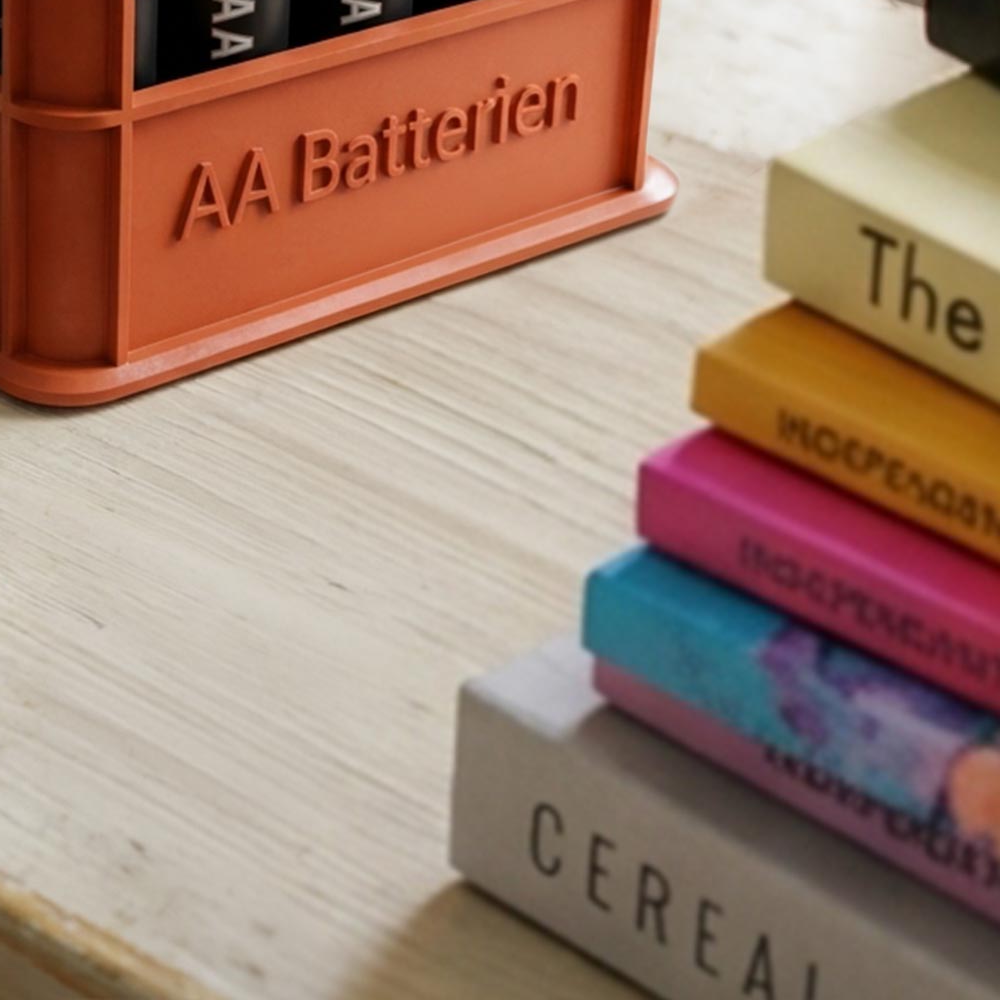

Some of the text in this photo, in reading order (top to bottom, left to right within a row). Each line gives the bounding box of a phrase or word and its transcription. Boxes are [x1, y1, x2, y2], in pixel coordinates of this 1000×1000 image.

[174, 72, 581, 241] AA Batterien
[857, 223, 985, 354] The
